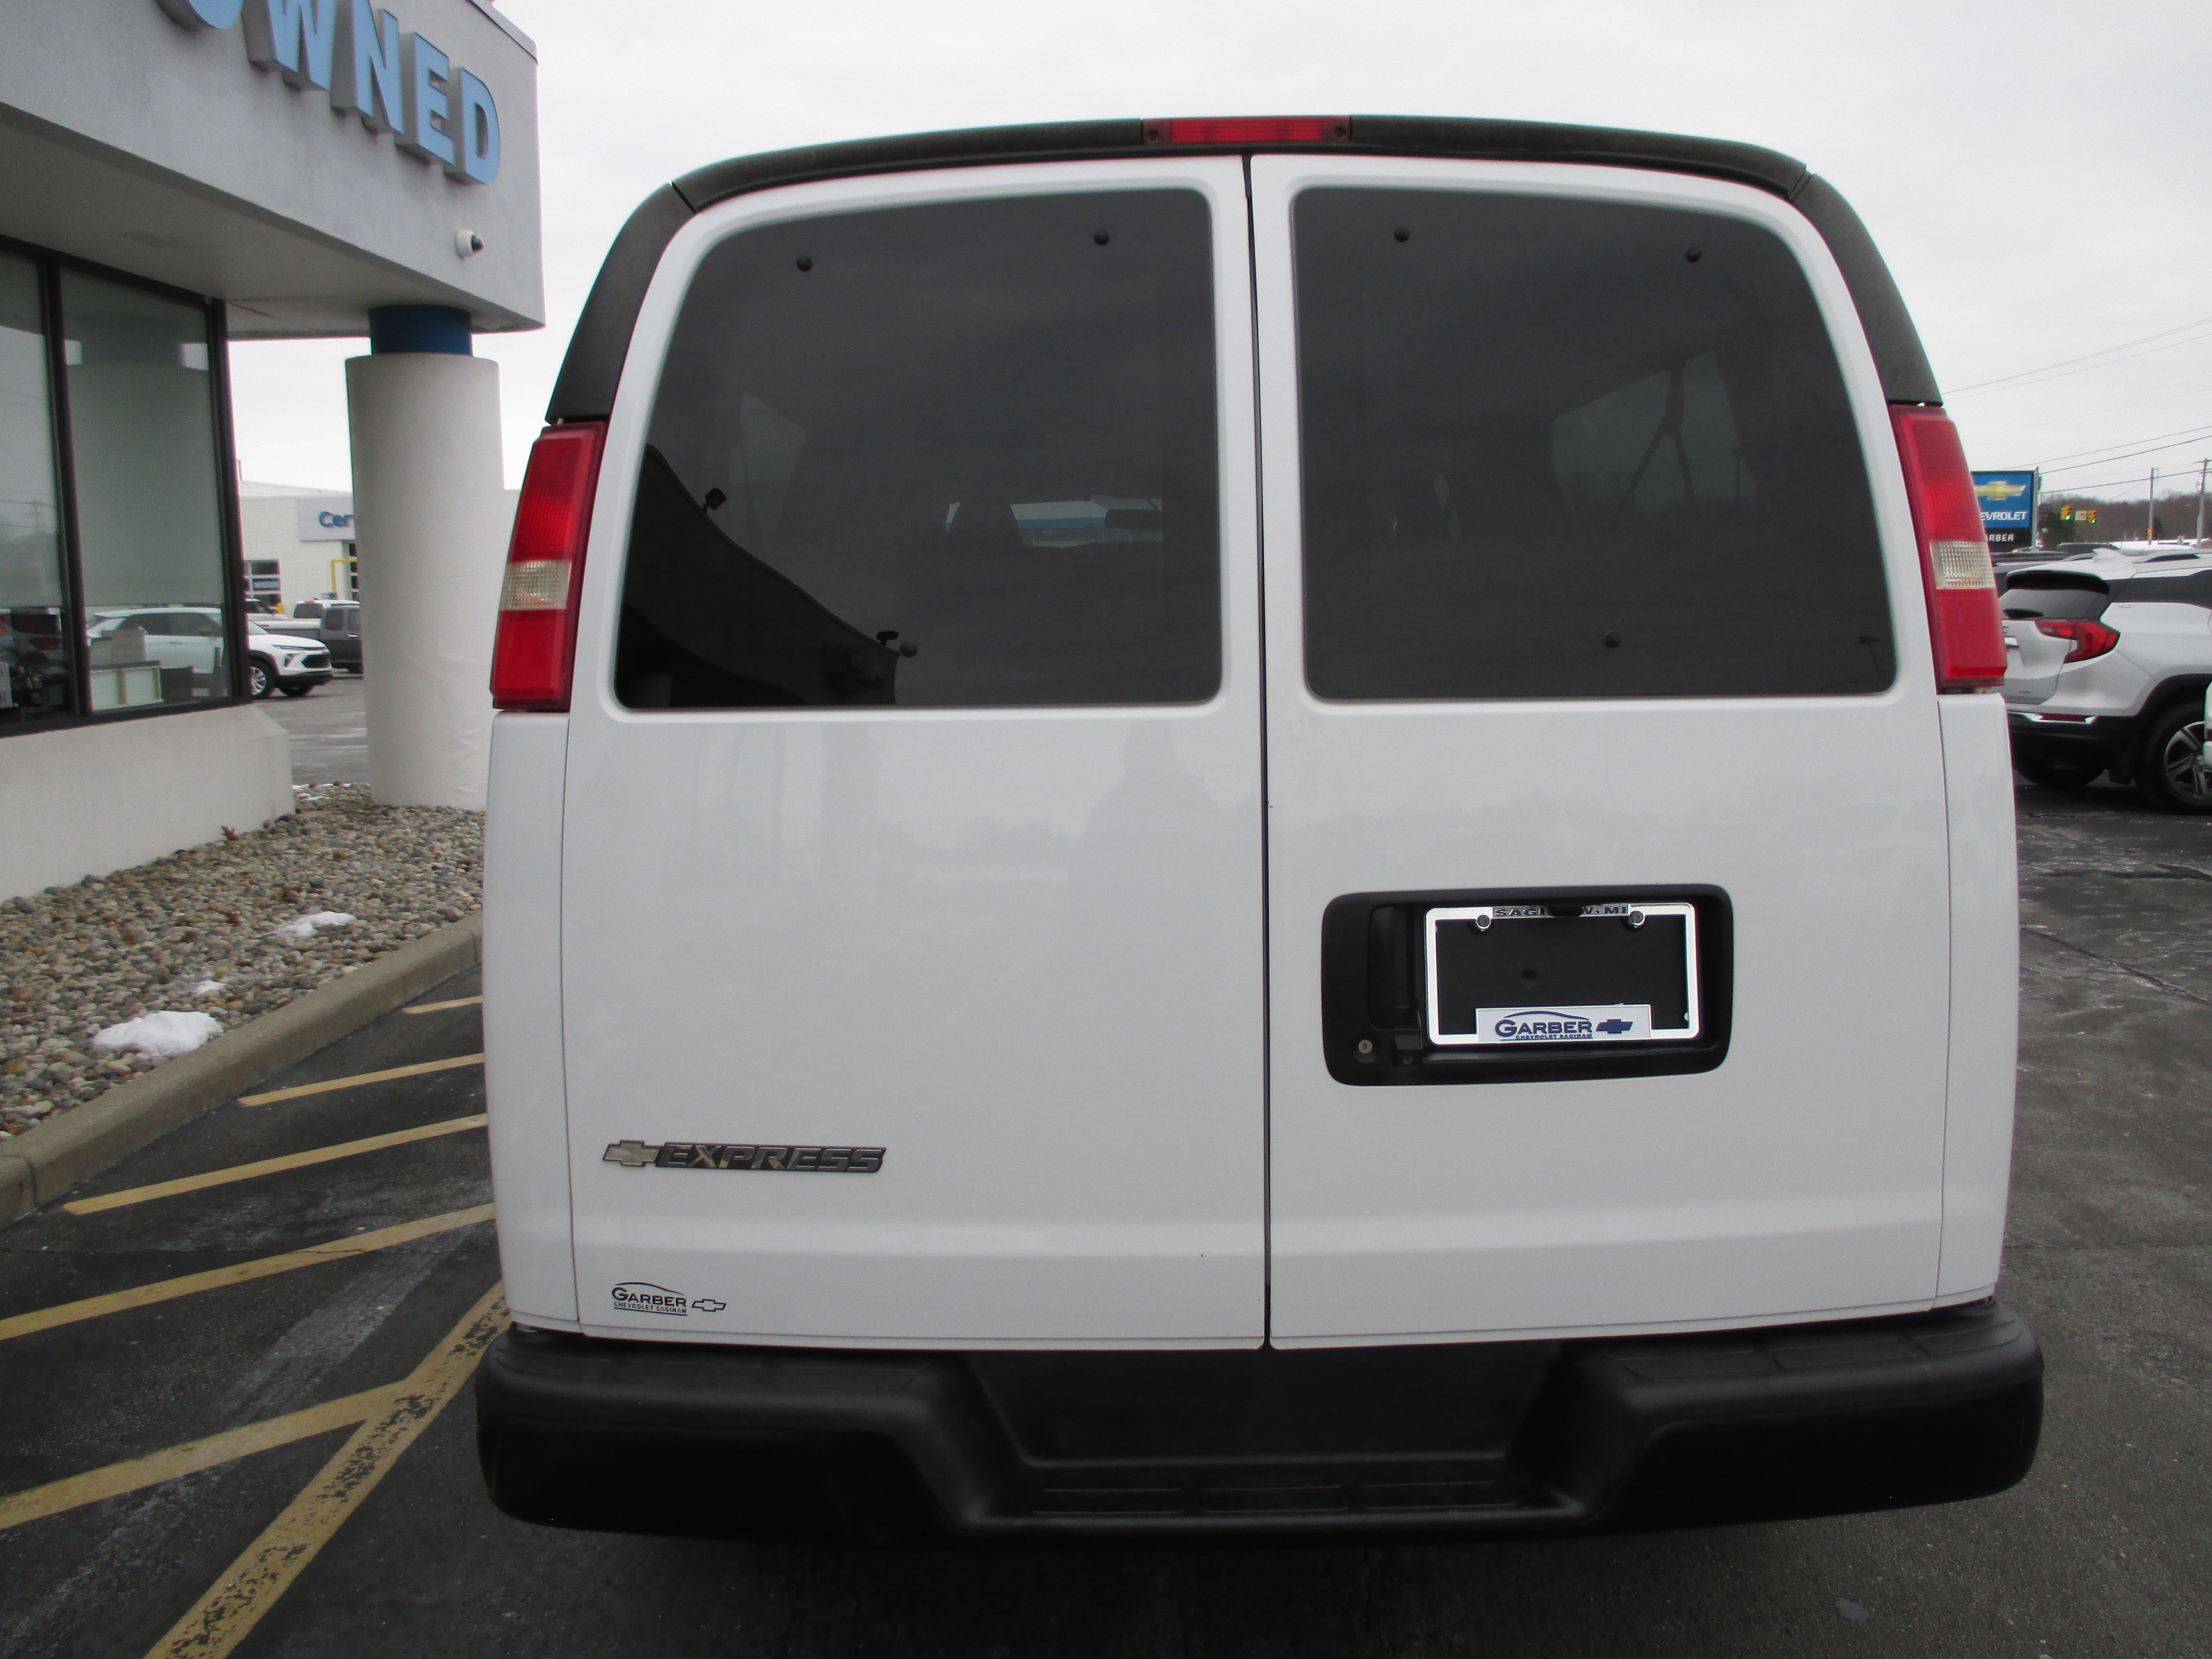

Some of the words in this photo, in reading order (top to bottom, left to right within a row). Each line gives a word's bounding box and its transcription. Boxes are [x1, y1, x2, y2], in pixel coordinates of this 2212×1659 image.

[188, 0, 500, 185] WNED
[1495, 1019, 1593, 1037] GARBER
[665, 1143, 884, 1171] EXPRESS
[612, 1287, 687, 1307] GARBER
[614, 1301, 654, 1310] CHEVROLET
[656, 1306, 687, 1314] SAGINAW
